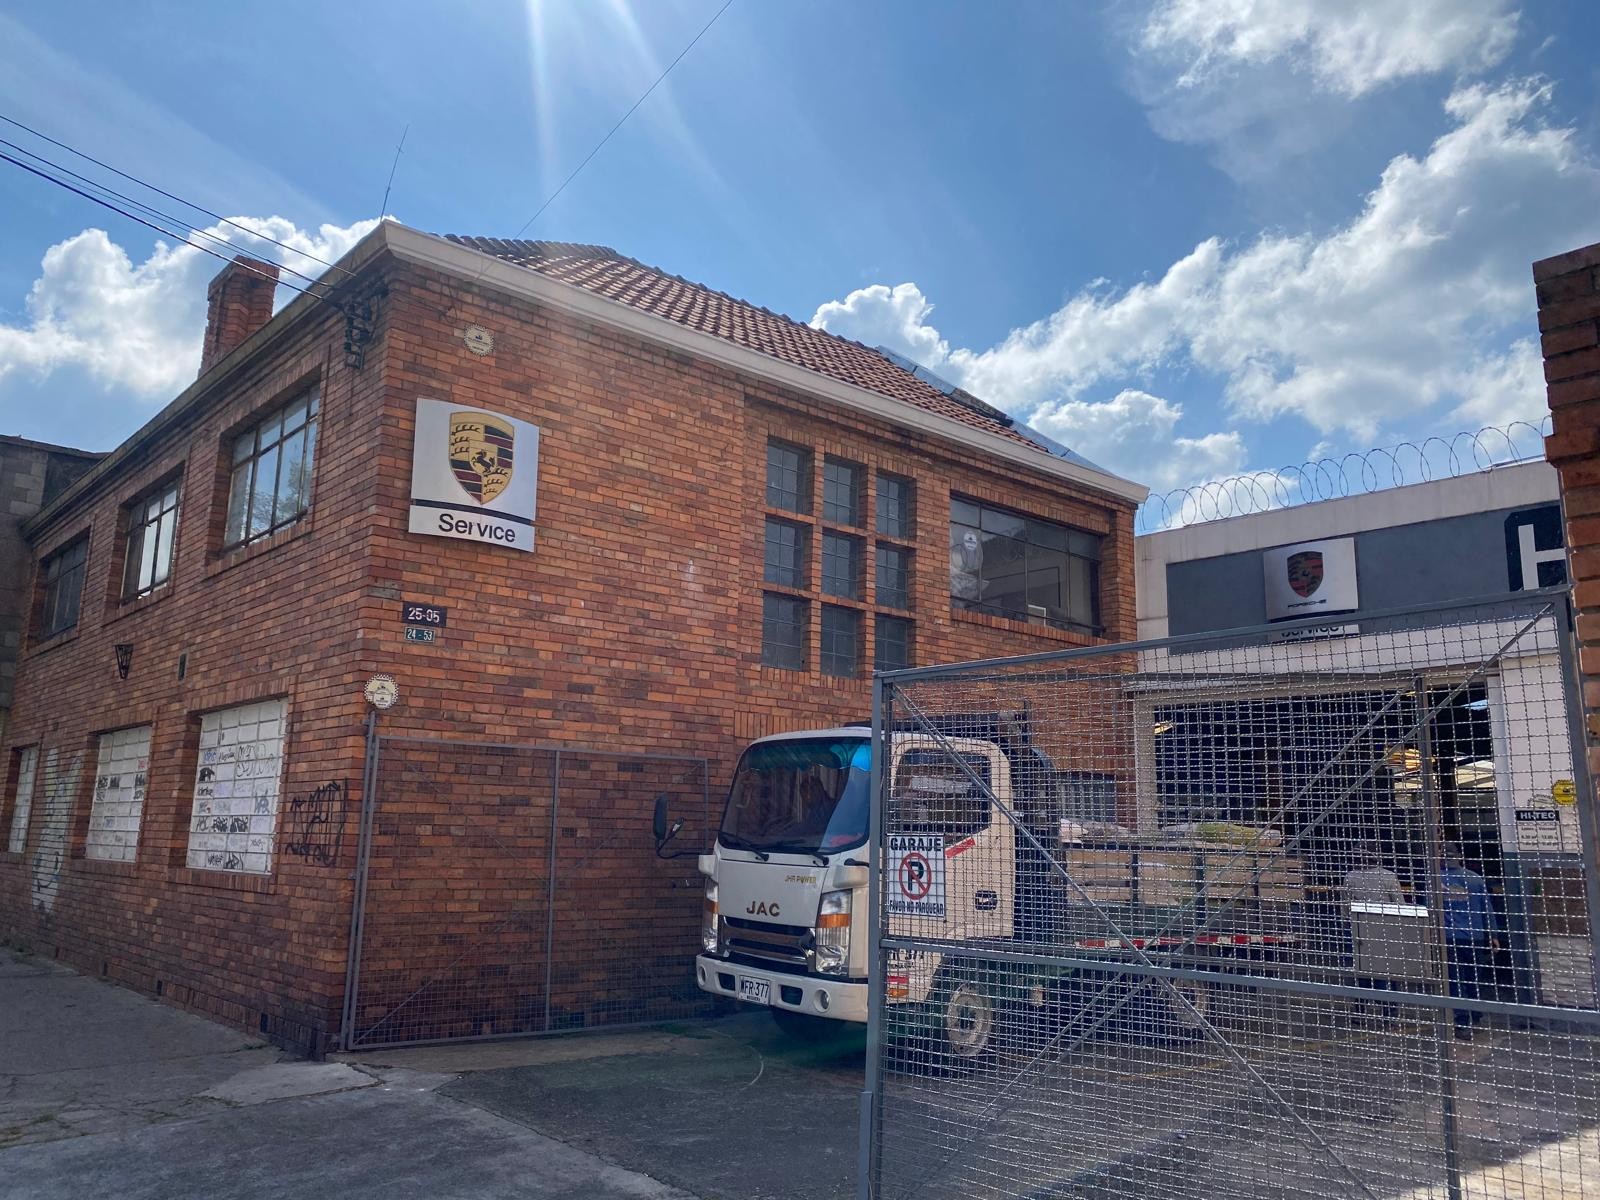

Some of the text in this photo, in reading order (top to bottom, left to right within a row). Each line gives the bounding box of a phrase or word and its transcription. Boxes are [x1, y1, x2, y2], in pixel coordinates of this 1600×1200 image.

[438, 513, 516, 543] Service
[407, 607, 440, 623] 25-05
[890, 837, 941, 852] GARAJE
[746, 900, 780, 917] JAC
[889, 900, 944, 915] FAVOR NO PARQUEAR
